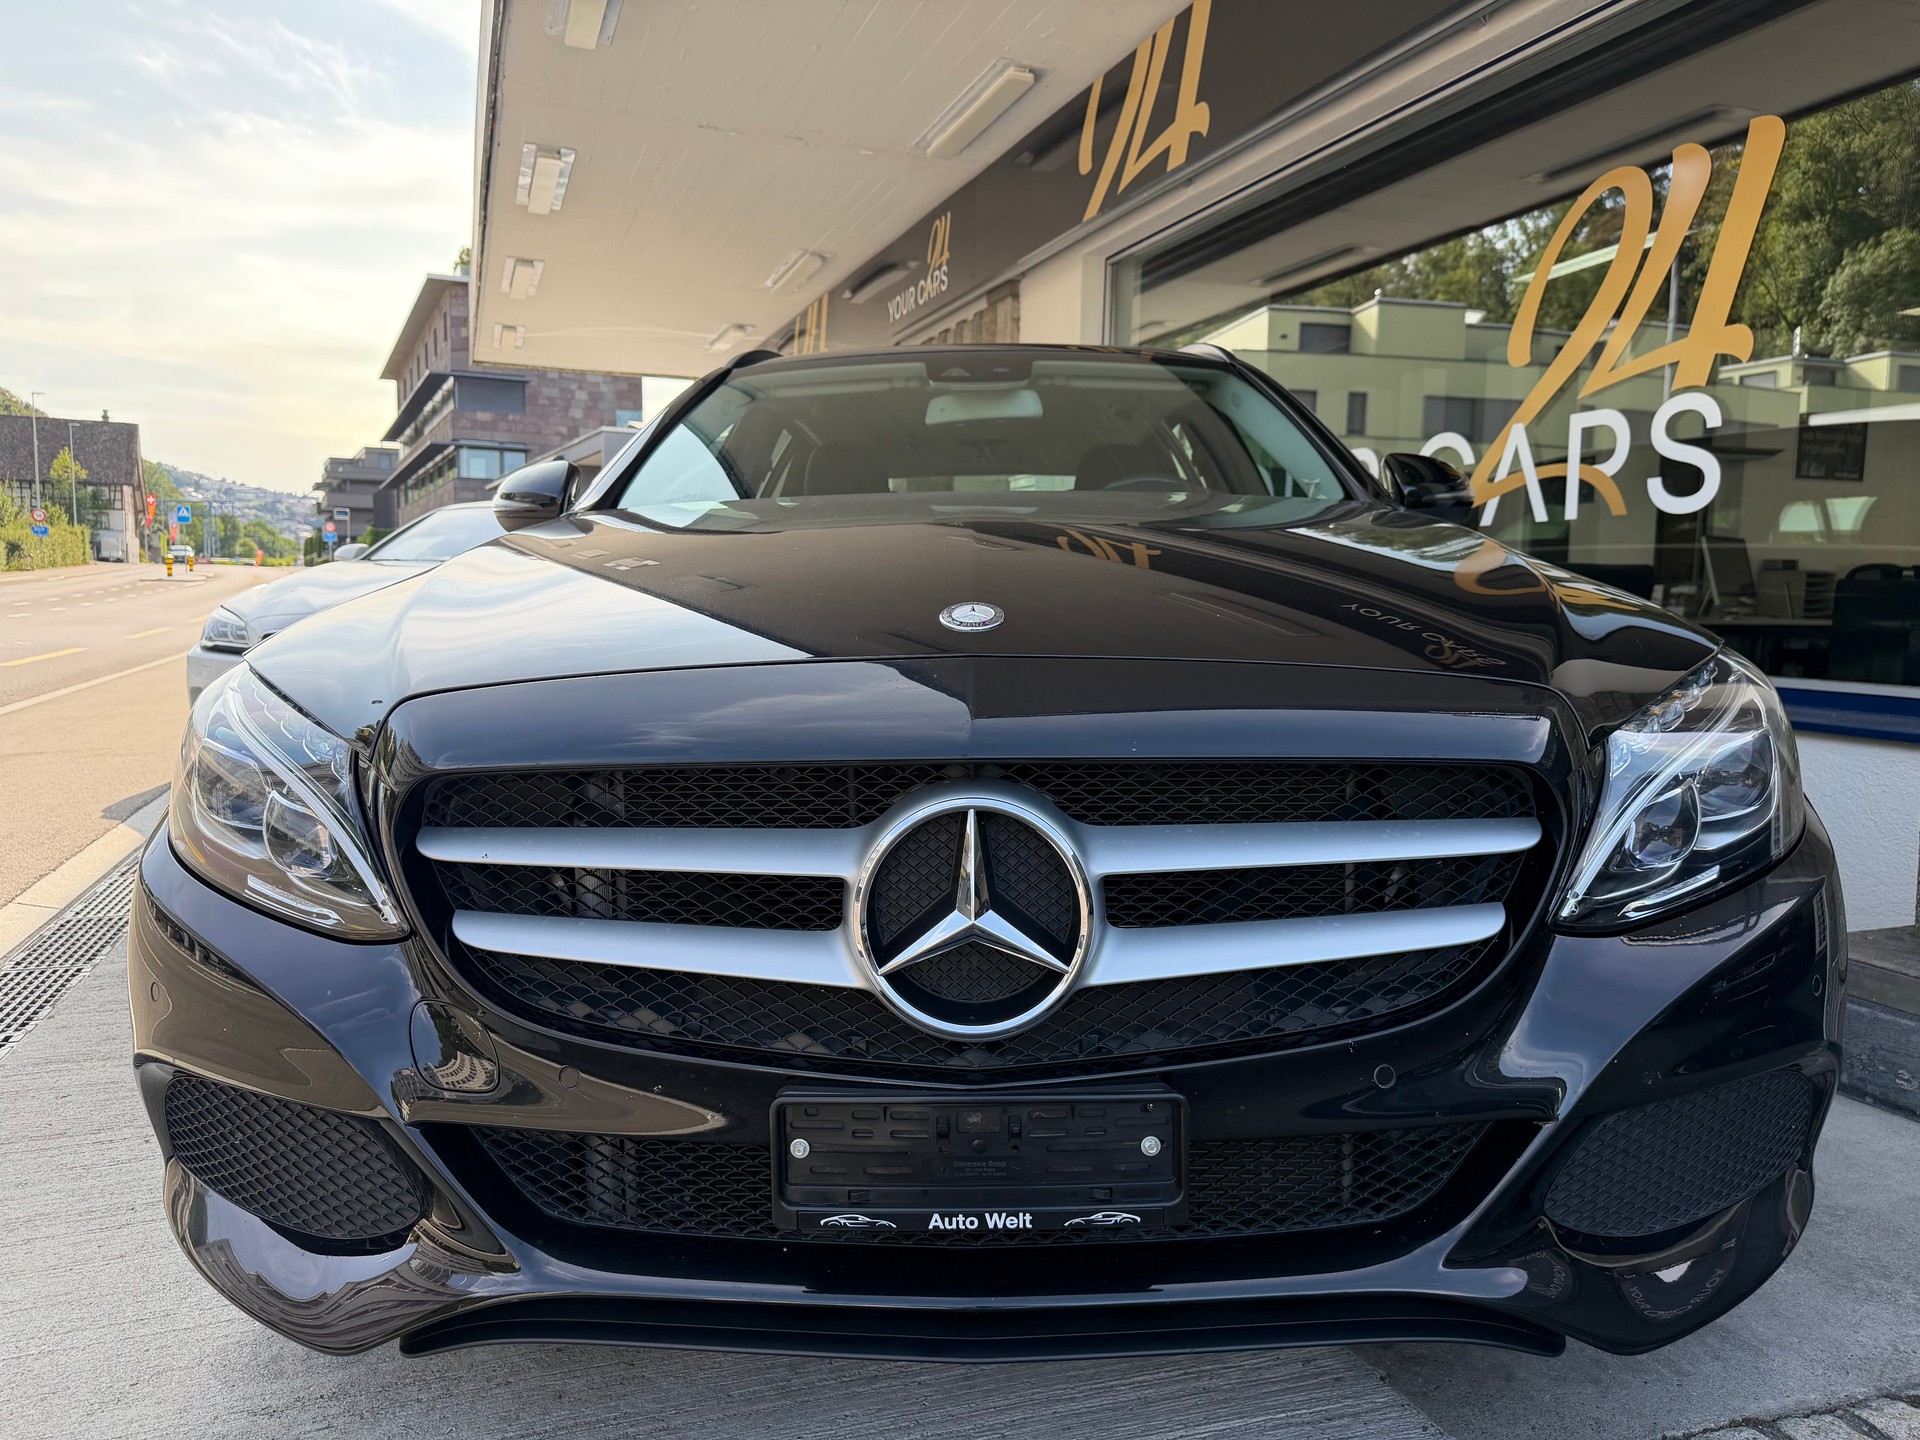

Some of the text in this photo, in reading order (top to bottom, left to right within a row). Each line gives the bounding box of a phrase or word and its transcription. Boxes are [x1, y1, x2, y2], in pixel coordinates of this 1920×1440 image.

[887, 264, 949, 323] YOUR CARS
[928, 1212, 1033, 1230] Auto Welt
